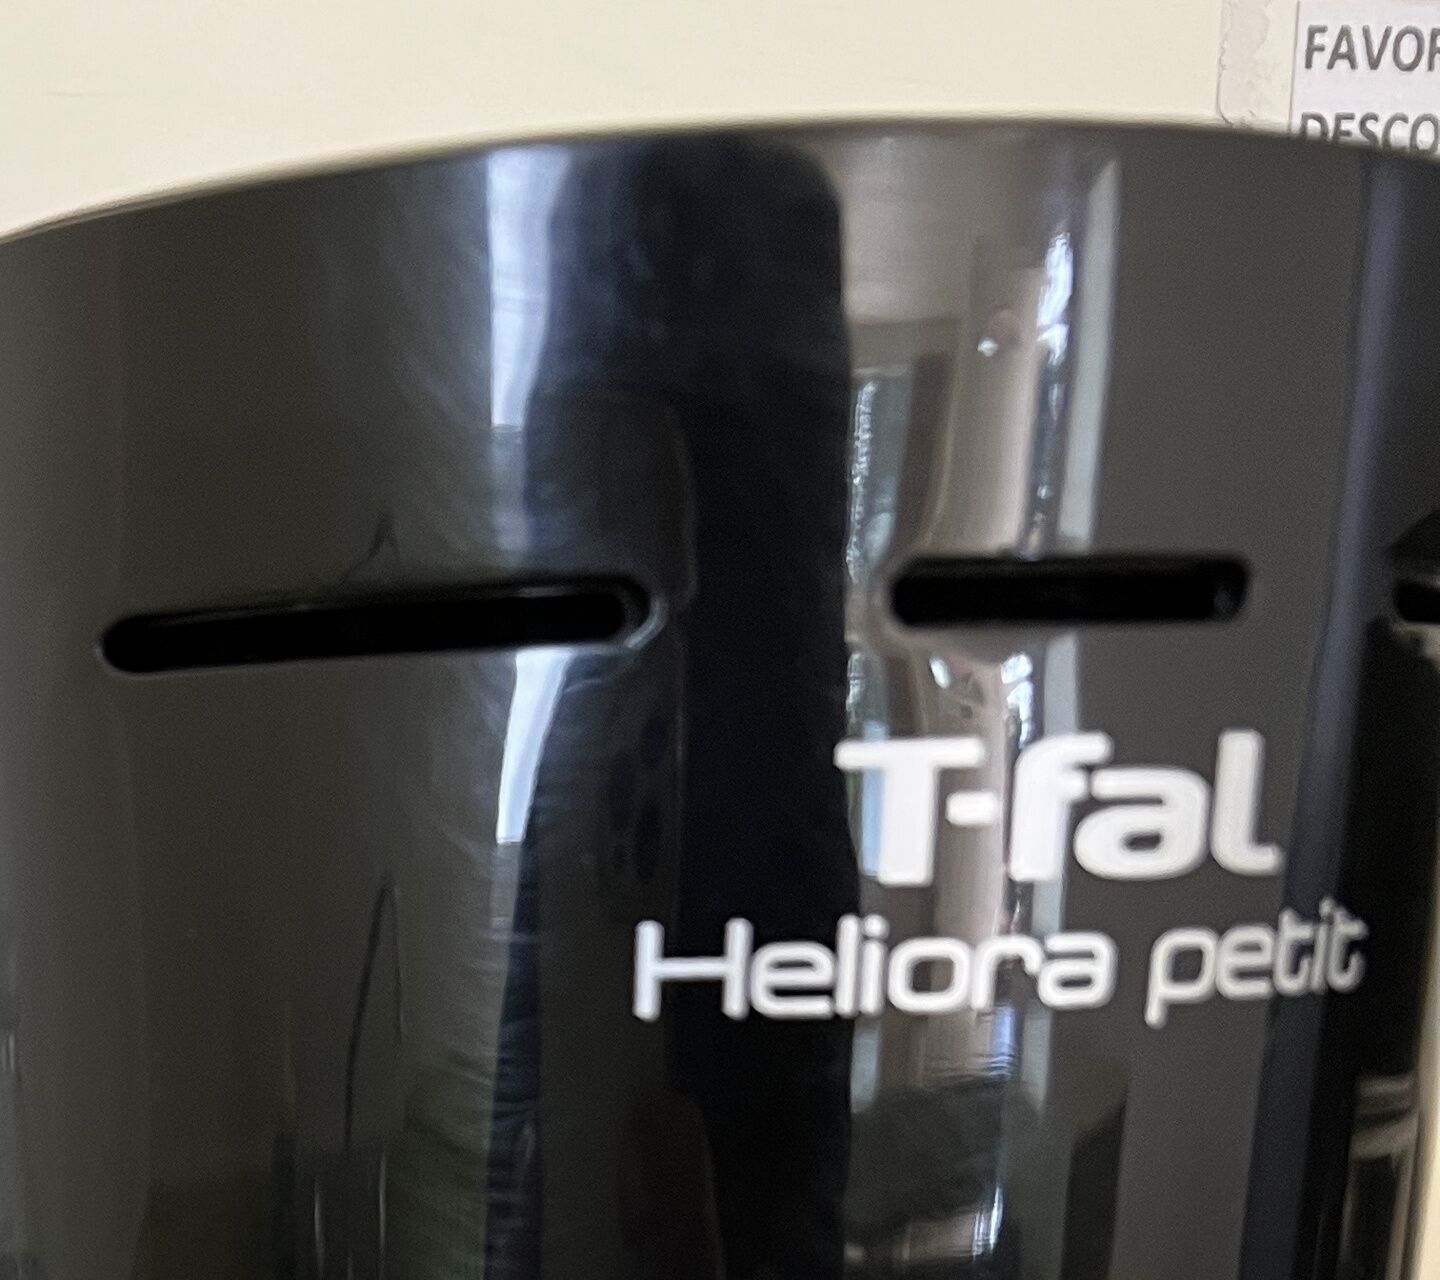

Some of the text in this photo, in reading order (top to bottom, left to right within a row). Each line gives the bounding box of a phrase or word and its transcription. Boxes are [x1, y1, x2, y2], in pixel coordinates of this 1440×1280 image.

[833, 728, 1285, 887] T-fal
[631, 897, 1368, 1029] Heliora petit
